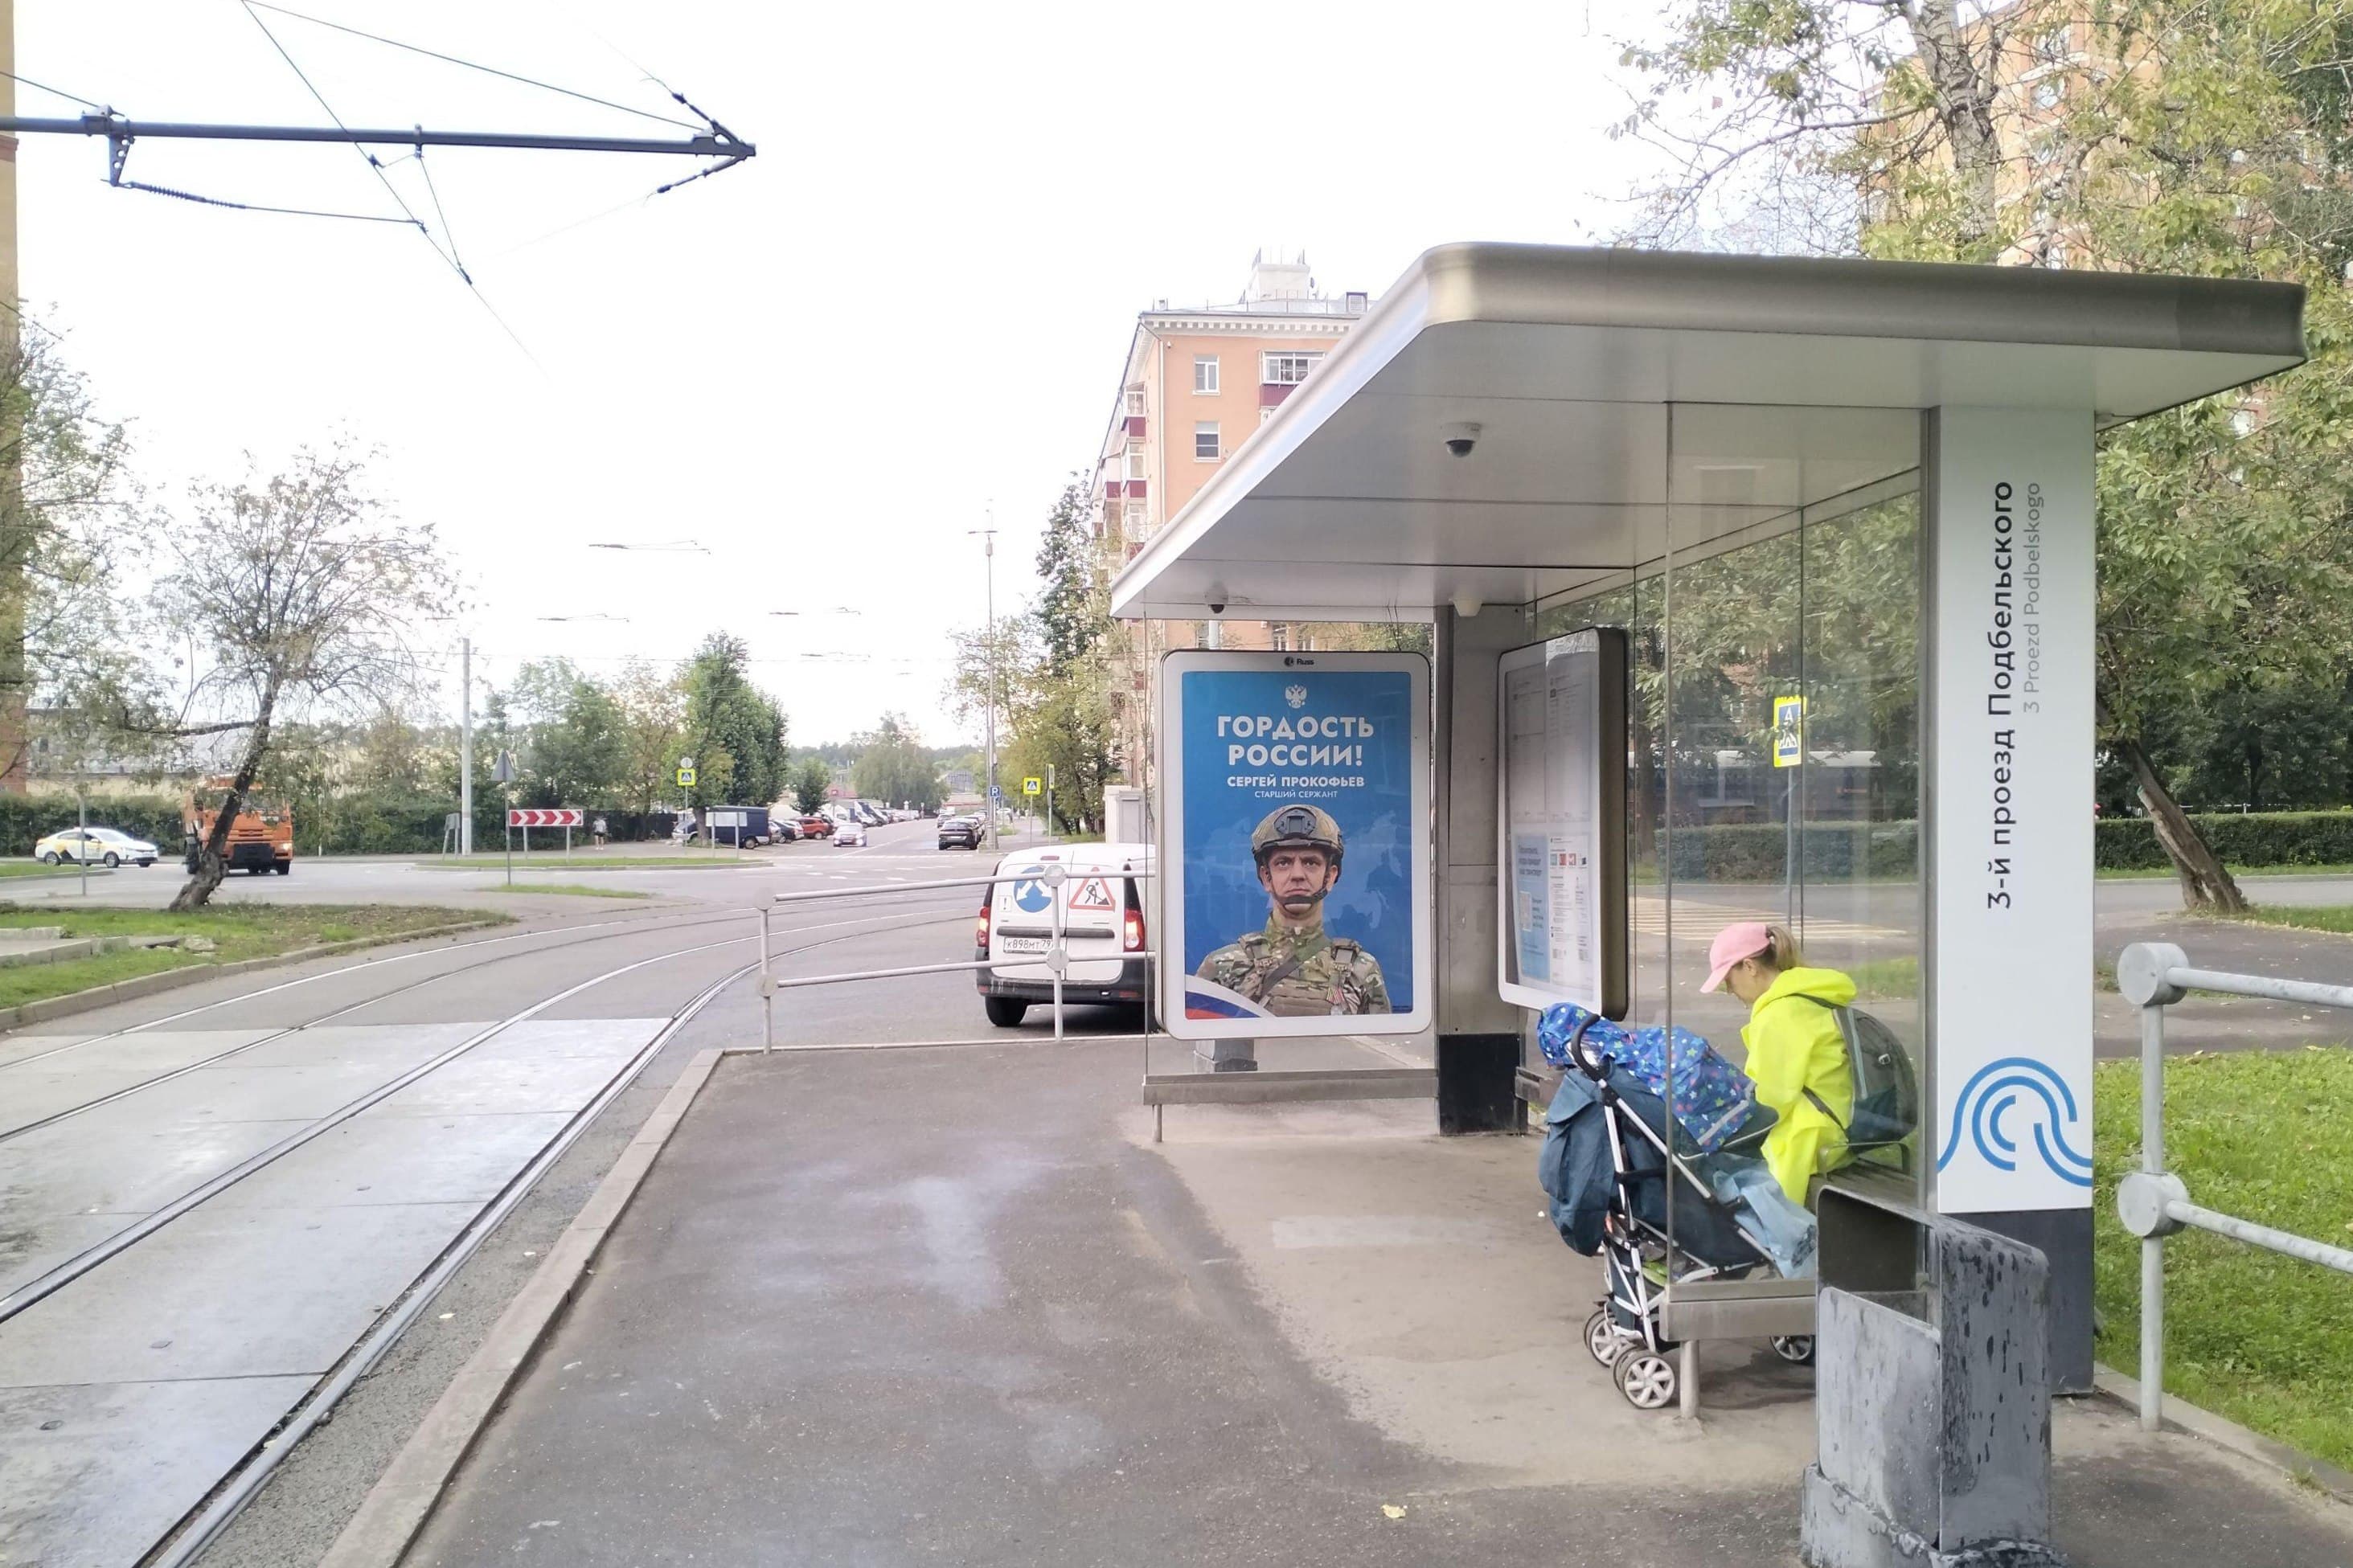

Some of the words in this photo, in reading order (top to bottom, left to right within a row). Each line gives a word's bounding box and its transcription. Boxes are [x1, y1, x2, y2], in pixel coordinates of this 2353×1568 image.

[2023, 482, 2044, 615] Podbelskogo
[1987, 482, 2015, 714] Подбельского
[2023, 623, 2039, 693] Proezd
[2023, 701, 2039, 713] 3
[1217, 715, 1374, 740] ГОРДОСТЬ
[1228, 744, 1363, 766] РОССИИ!
[1227, 774, 1277, 787] СЕРГЕЙ
[1281, 776, 1365, 787] ПРОКОФЬЕВ
[1994, 729, 2017, 845] проезд
[1254, 789, 1296, 798] СТАРШИЙ
[1298, 790, 1338, 798] СЕРЖАНТ
[1987, 858, 2011, 909] 3-й
[1041, 939, 1054, 948] 79
